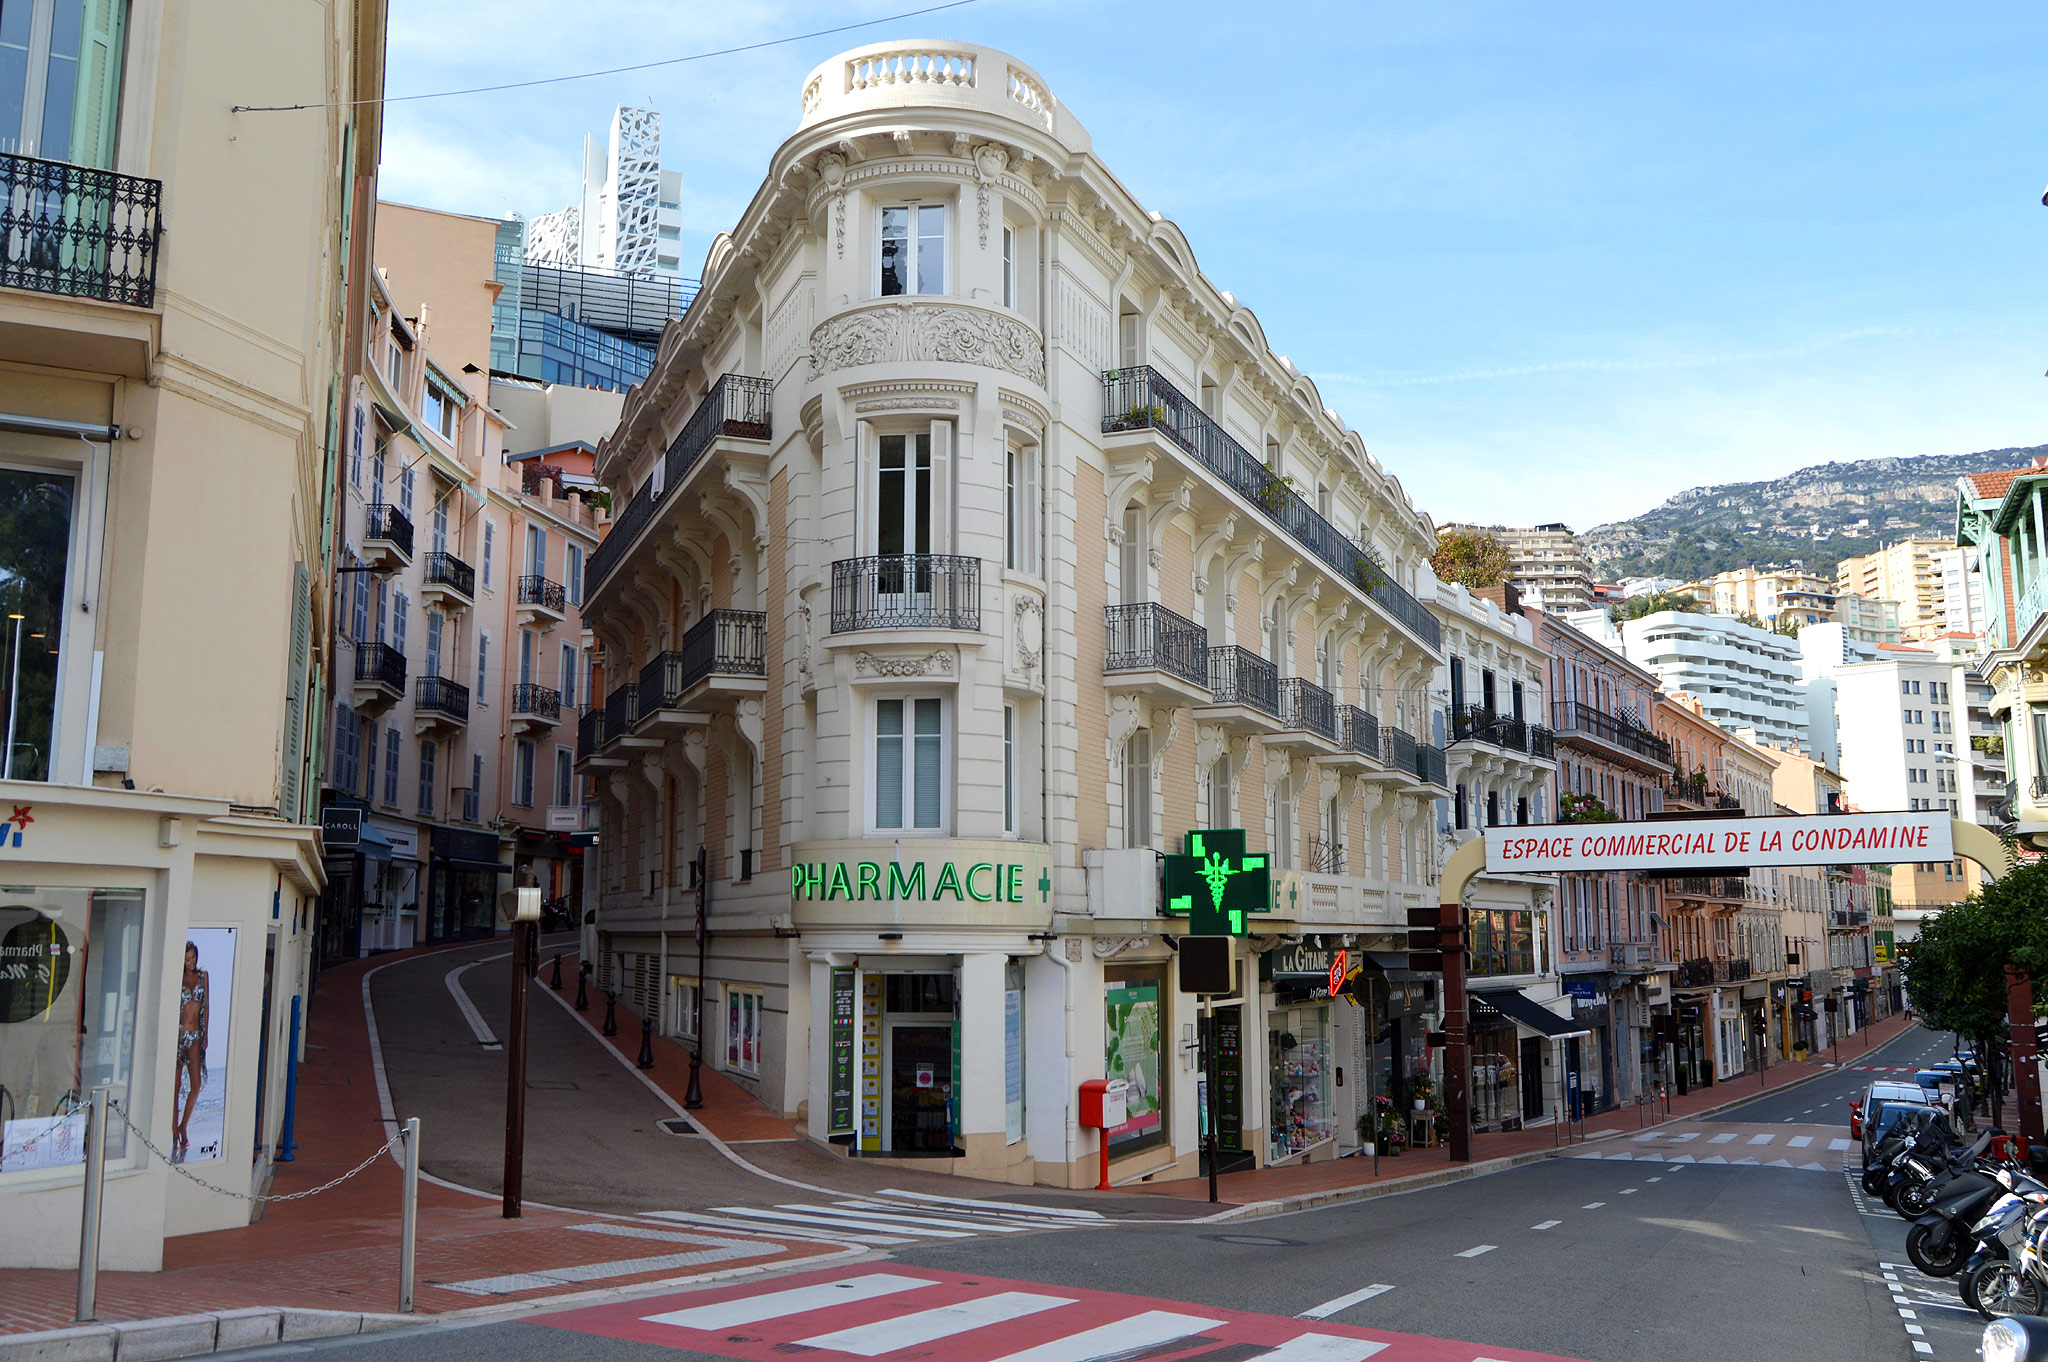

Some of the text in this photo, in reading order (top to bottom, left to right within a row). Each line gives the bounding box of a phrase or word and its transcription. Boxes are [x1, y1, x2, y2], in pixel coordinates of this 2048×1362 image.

[324, 822, 358, 830] CAROLL
[1502, 826, 1929, 859] ESPACE COMMERCIAL DE LA CONDAMINE
[791, 861, 1024, 902] PHARMACIE
[1282, 955, 1295, 972] LA
